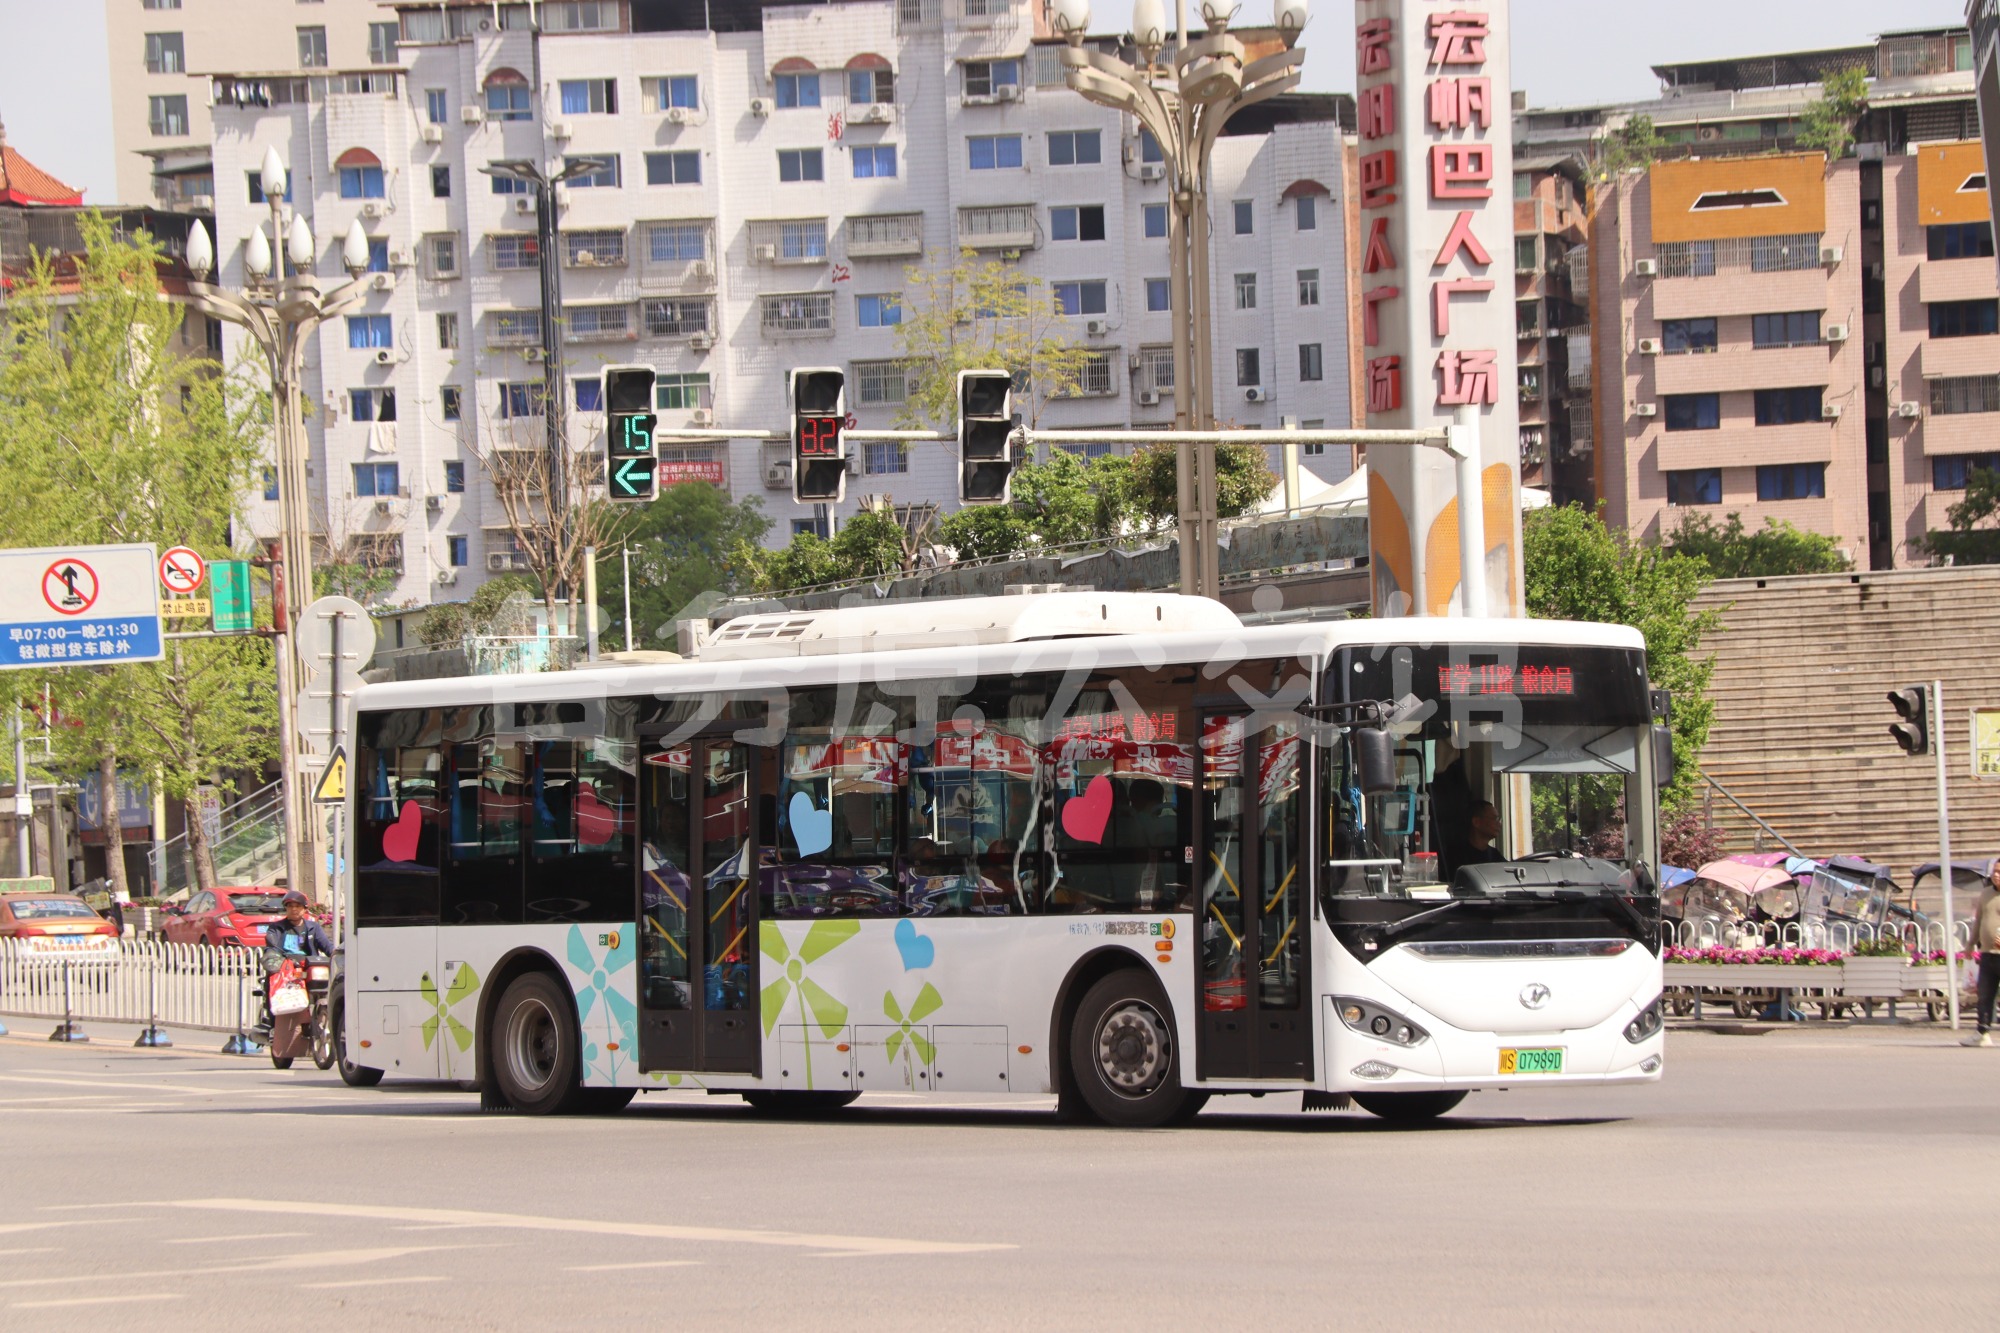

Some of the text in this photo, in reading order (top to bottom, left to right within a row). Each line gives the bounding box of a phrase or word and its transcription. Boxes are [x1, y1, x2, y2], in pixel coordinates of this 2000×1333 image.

[1357, 17, 1401, 413] 宏帆巴人广场
[1428, 10, 1498, 405] 宏帆巴人广场
[624, 415, 650, 450] 15
[801, 418, 836, 453] 82
[162, 602, 206, 614] 禁止鸣笛
[18, 639, 132, 660] 轻微型货车除外
[1521, 665, 1573, 694] 粮食局
